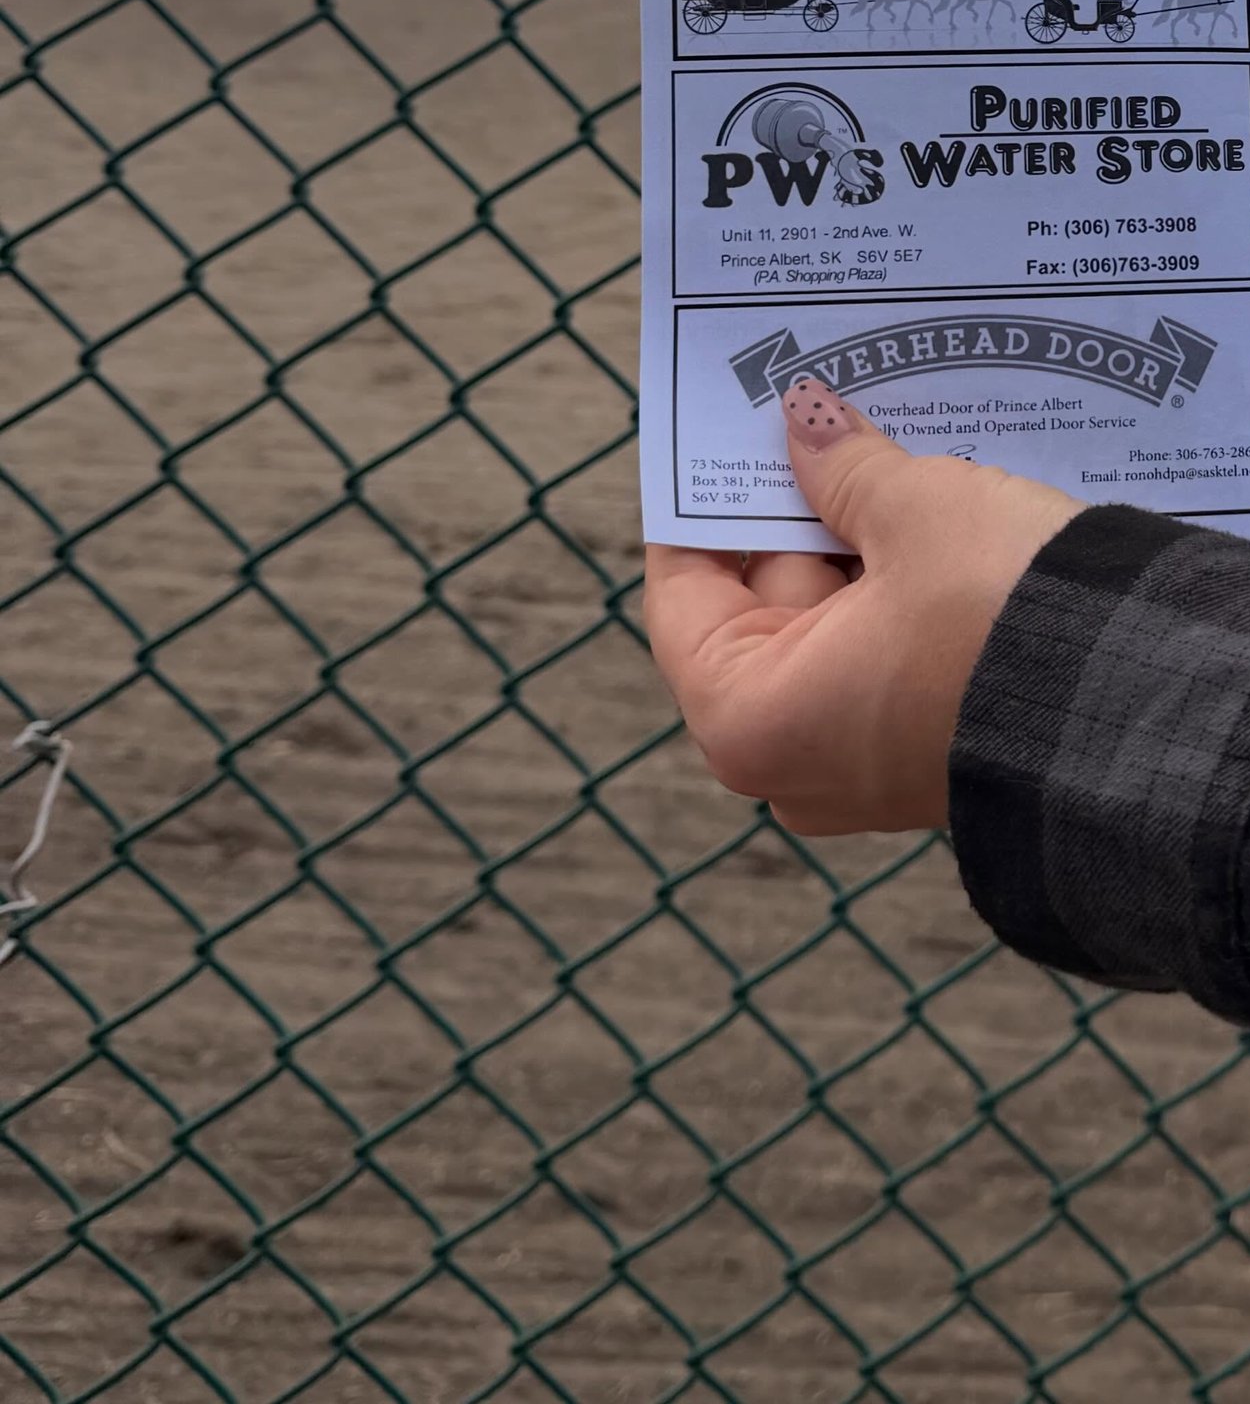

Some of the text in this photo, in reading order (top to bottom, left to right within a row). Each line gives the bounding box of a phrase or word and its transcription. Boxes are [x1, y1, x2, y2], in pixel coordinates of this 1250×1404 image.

[970, 85, 1181, 131] PURIFIED
[900, 135, 1246, 188] WATER STORE
[701, 149, 885, 207] PWS
[723, 230, 751, 242] Unit
[759, 229, 774, 241] 11,
[781, 227, 815, 240] 2901
[833, 226, 858, 239] 2nd
[862, 226, 892, 238] Ave.
[898, 225, 916, 236] W.
[1028, 217, 1196, 238] Ph: (306) 763-3908
[722, 249, 922, 267] Prince Albert, SK S6V 5E7
[1027, 254, 1201, 279] Fax: (306)763-3909
[786, 269, 845, 284] Shopping
[848, 268, 886, 282] Plaza)
[1045, 332, 1161, 391] DOOR
[869, 398, 1082, 416] Overhead Door of Prince Albert
[903, 421, 951, 435] Owned
[956, 420, 980, 433] and
[985, 418, 1046, 436] Operated
[1051, 418, 1085, 429] Door
[1089, 417, 1136, 428] Service
[1130, 450, 1171, 461] Phone:
[691, 460, 791, 471] 73 North Indus
[693, 475, 797, 488] Box 381, Prince
[1082, 469, 1120, 482] Email:
[693, 493, 749, 503] S6V 5R7
